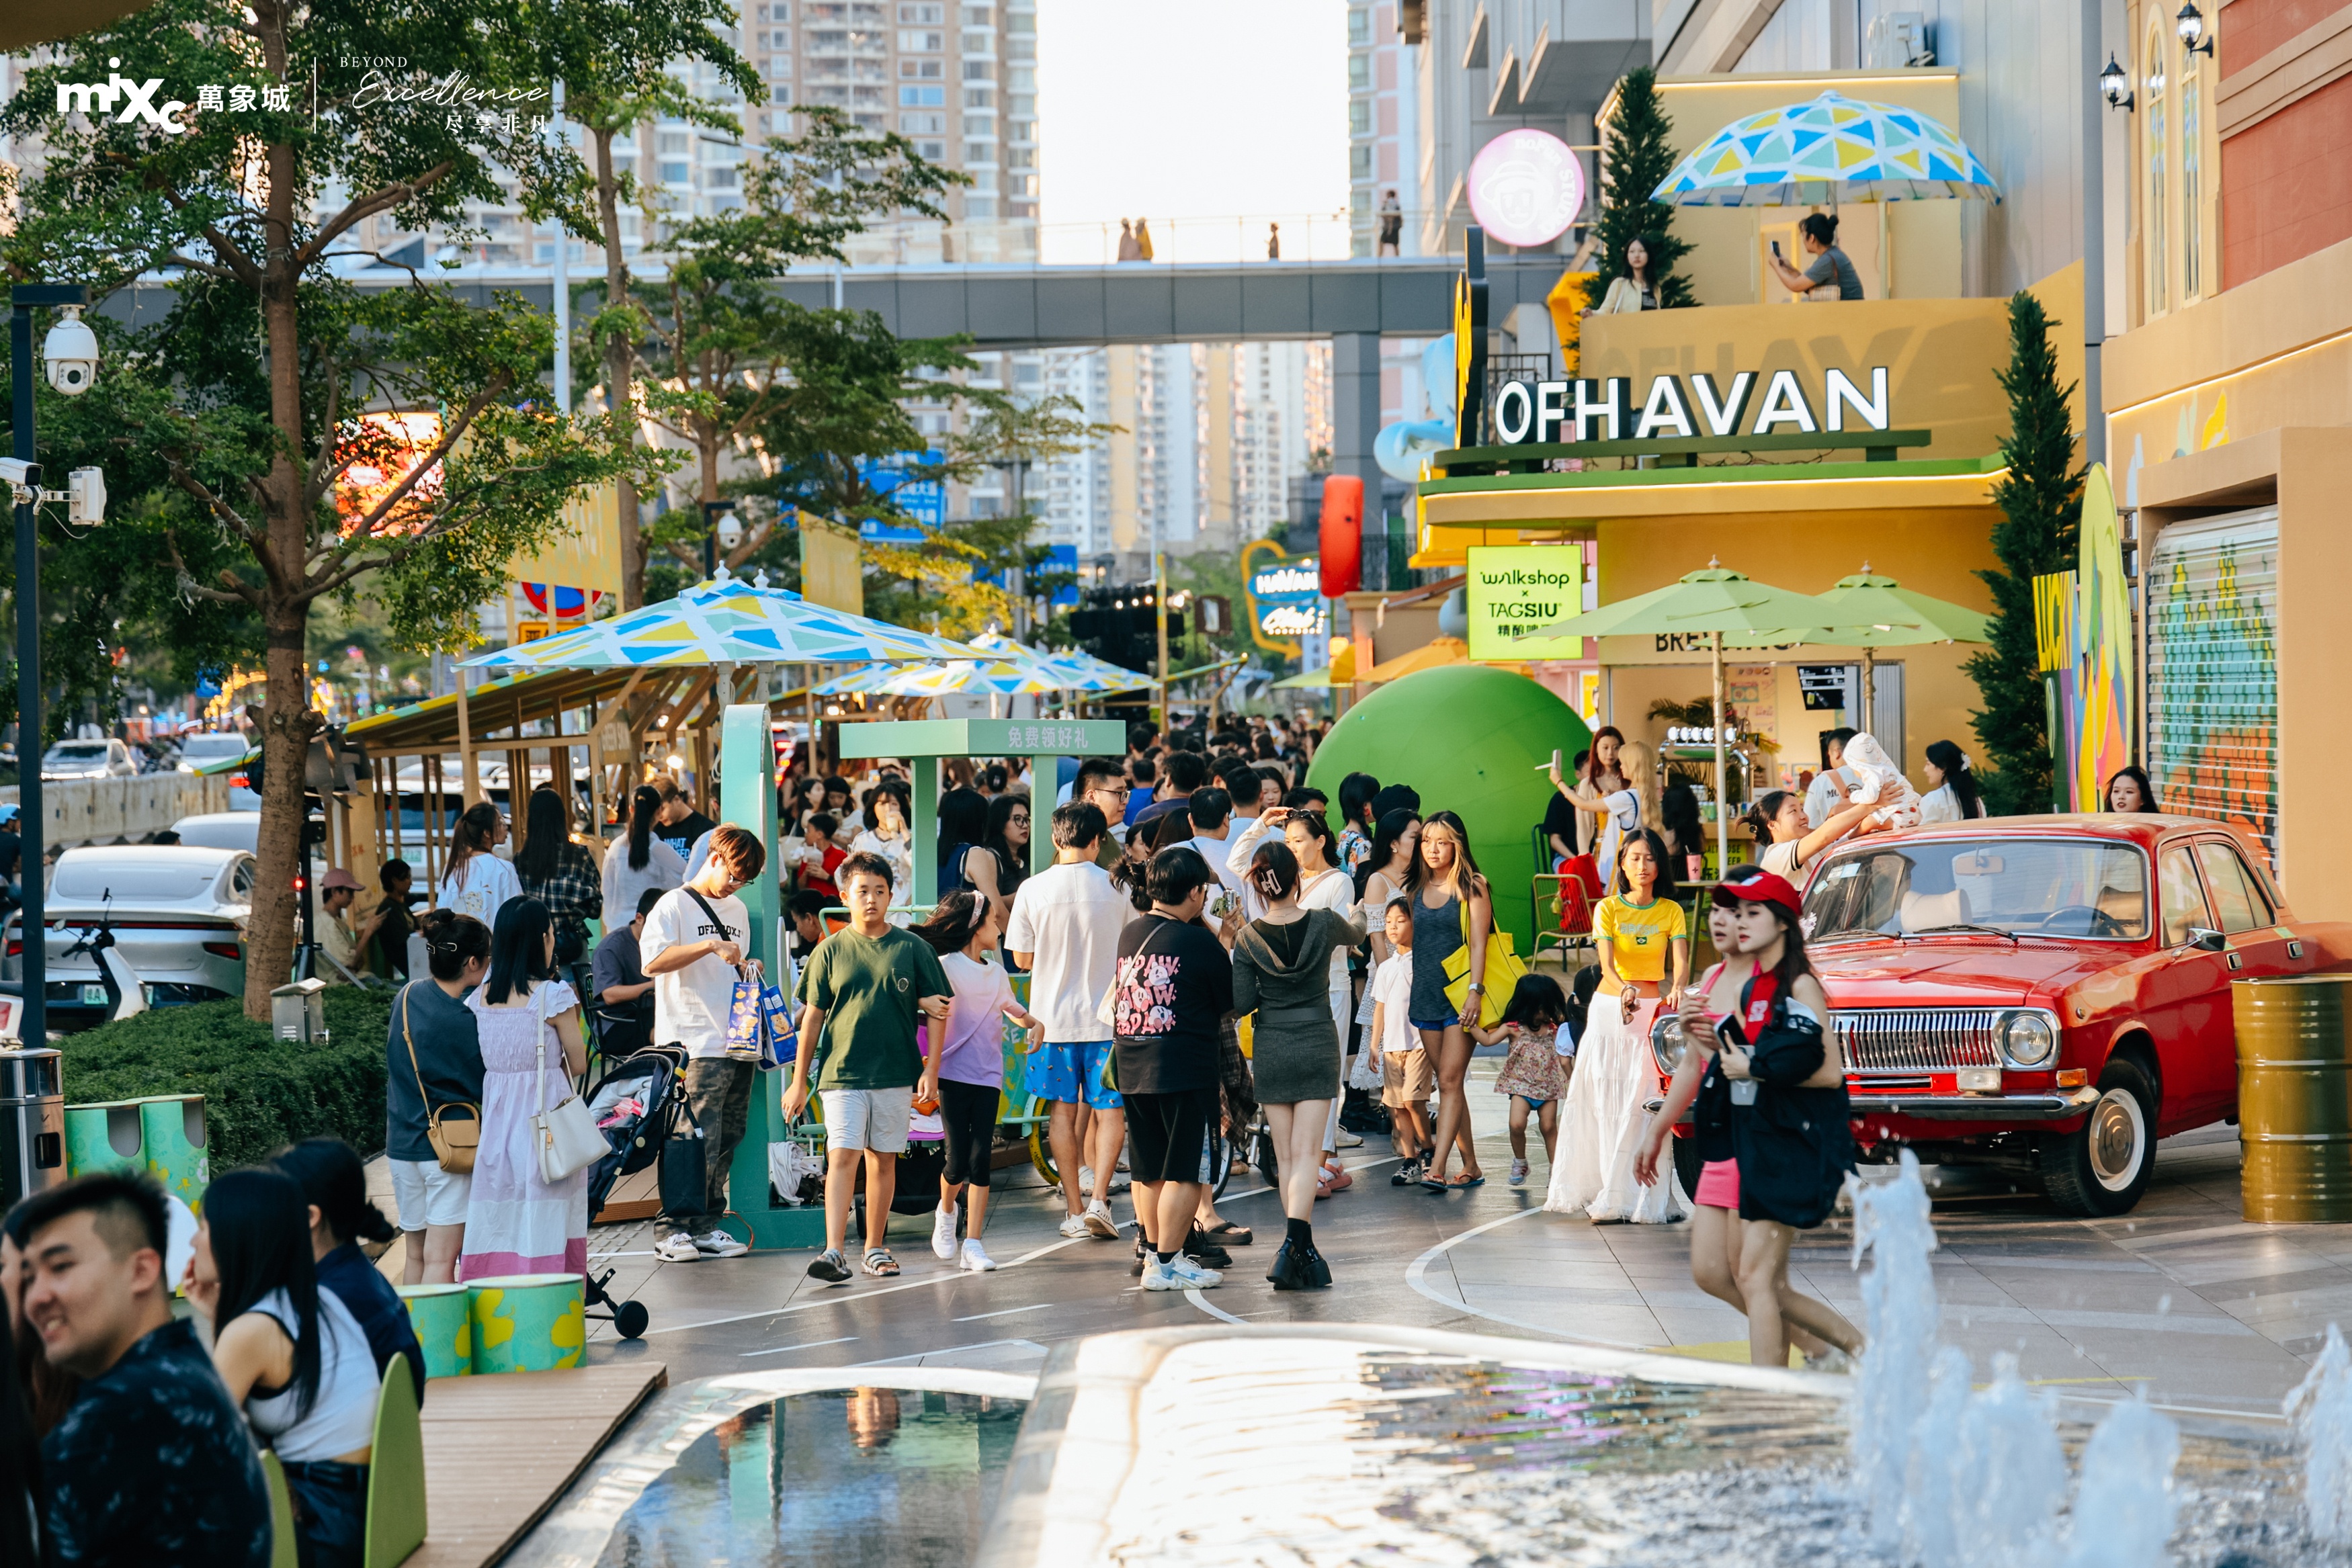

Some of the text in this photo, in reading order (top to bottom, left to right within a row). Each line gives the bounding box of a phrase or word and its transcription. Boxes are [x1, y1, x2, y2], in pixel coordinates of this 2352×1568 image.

[1008, 726, 1089, 748] 免费领好礼
